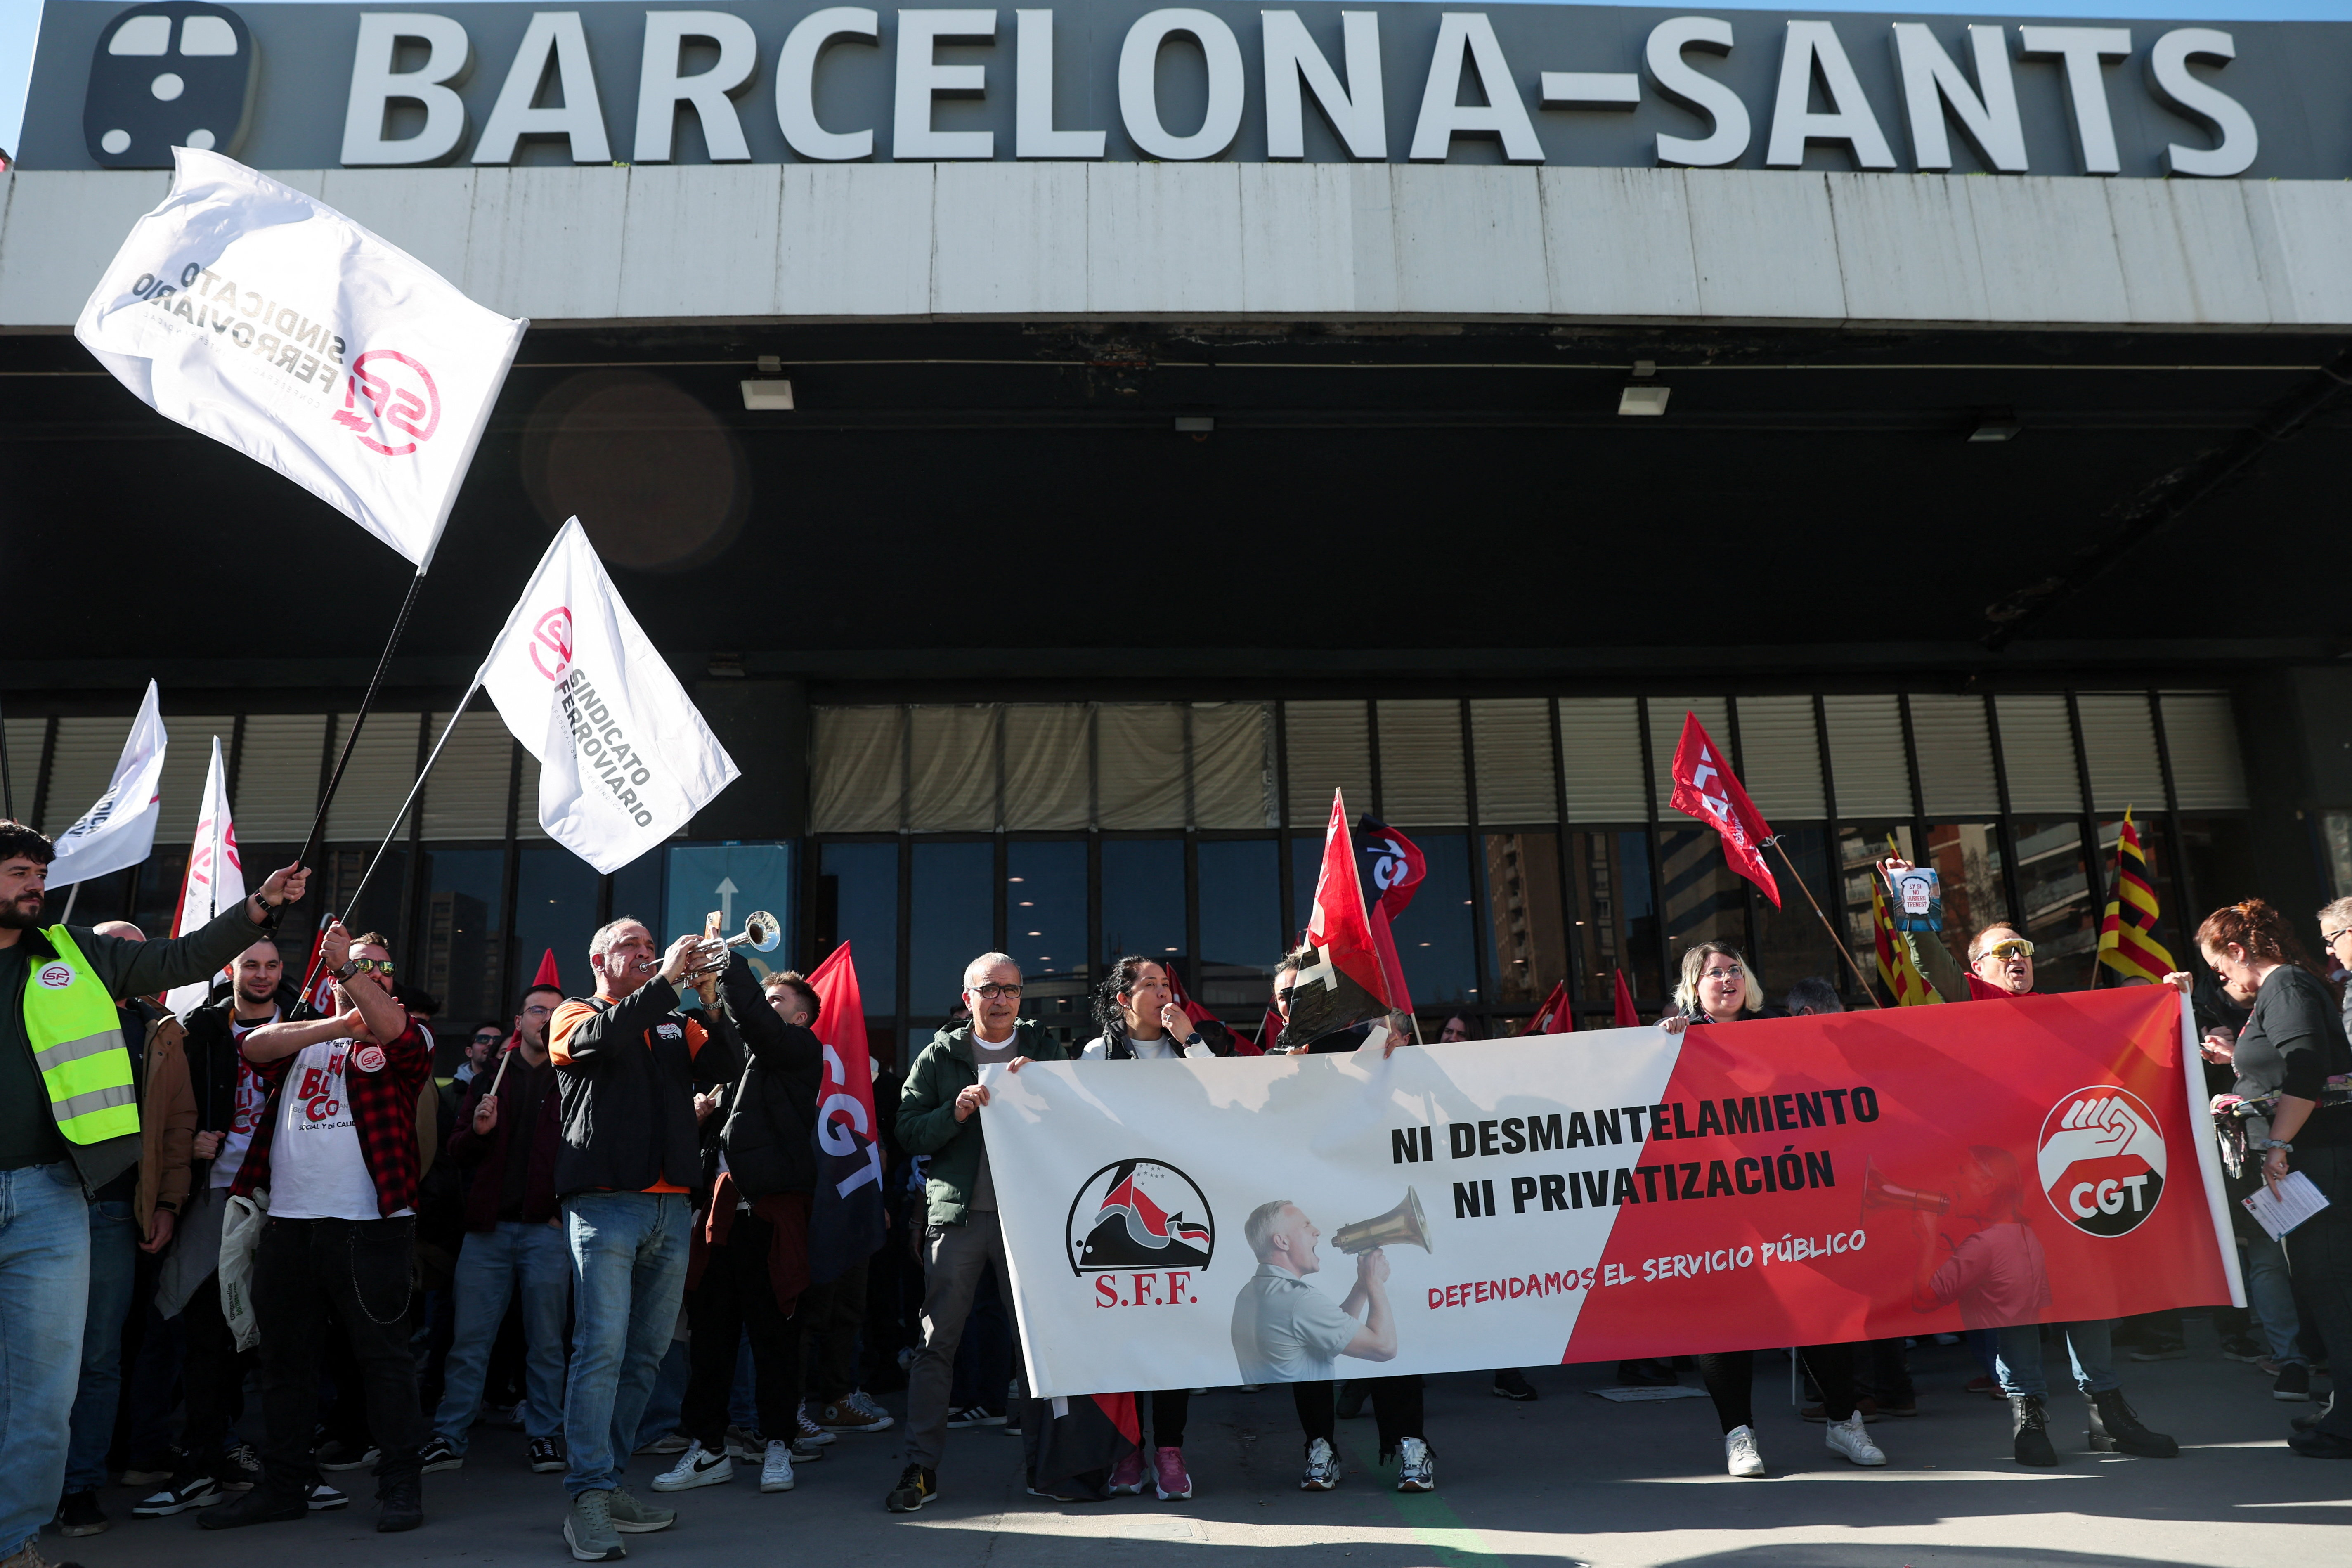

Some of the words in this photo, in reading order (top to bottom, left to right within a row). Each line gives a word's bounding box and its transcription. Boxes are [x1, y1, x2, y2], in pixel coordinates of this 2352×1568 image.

[554, 679, 652, 827] FERROVIARIO
[570, 669, 650, 786] SINDICATO
[1391, 1126, 1433, 1164] NI
[1449, 1086, 1880, 1159] DESMANTELAMIENTO
[1453, 1180, 1496, 1219] NI
[1511, 1145, 1836, 1214] PRIVATIZACIÓN
[2069, 1175, 2148, 1219] CGT
[1095, 1271, 1198, 1308] S.F.F.
[1428, 1267, 1596, 1310] DEFENDAMOS
[1603, 1263, 1636, 1287] EL
[1641, 1244, 1754, 1282] SERVICIO
[1760, 1229, 1867, 1266] PÚBLICO
